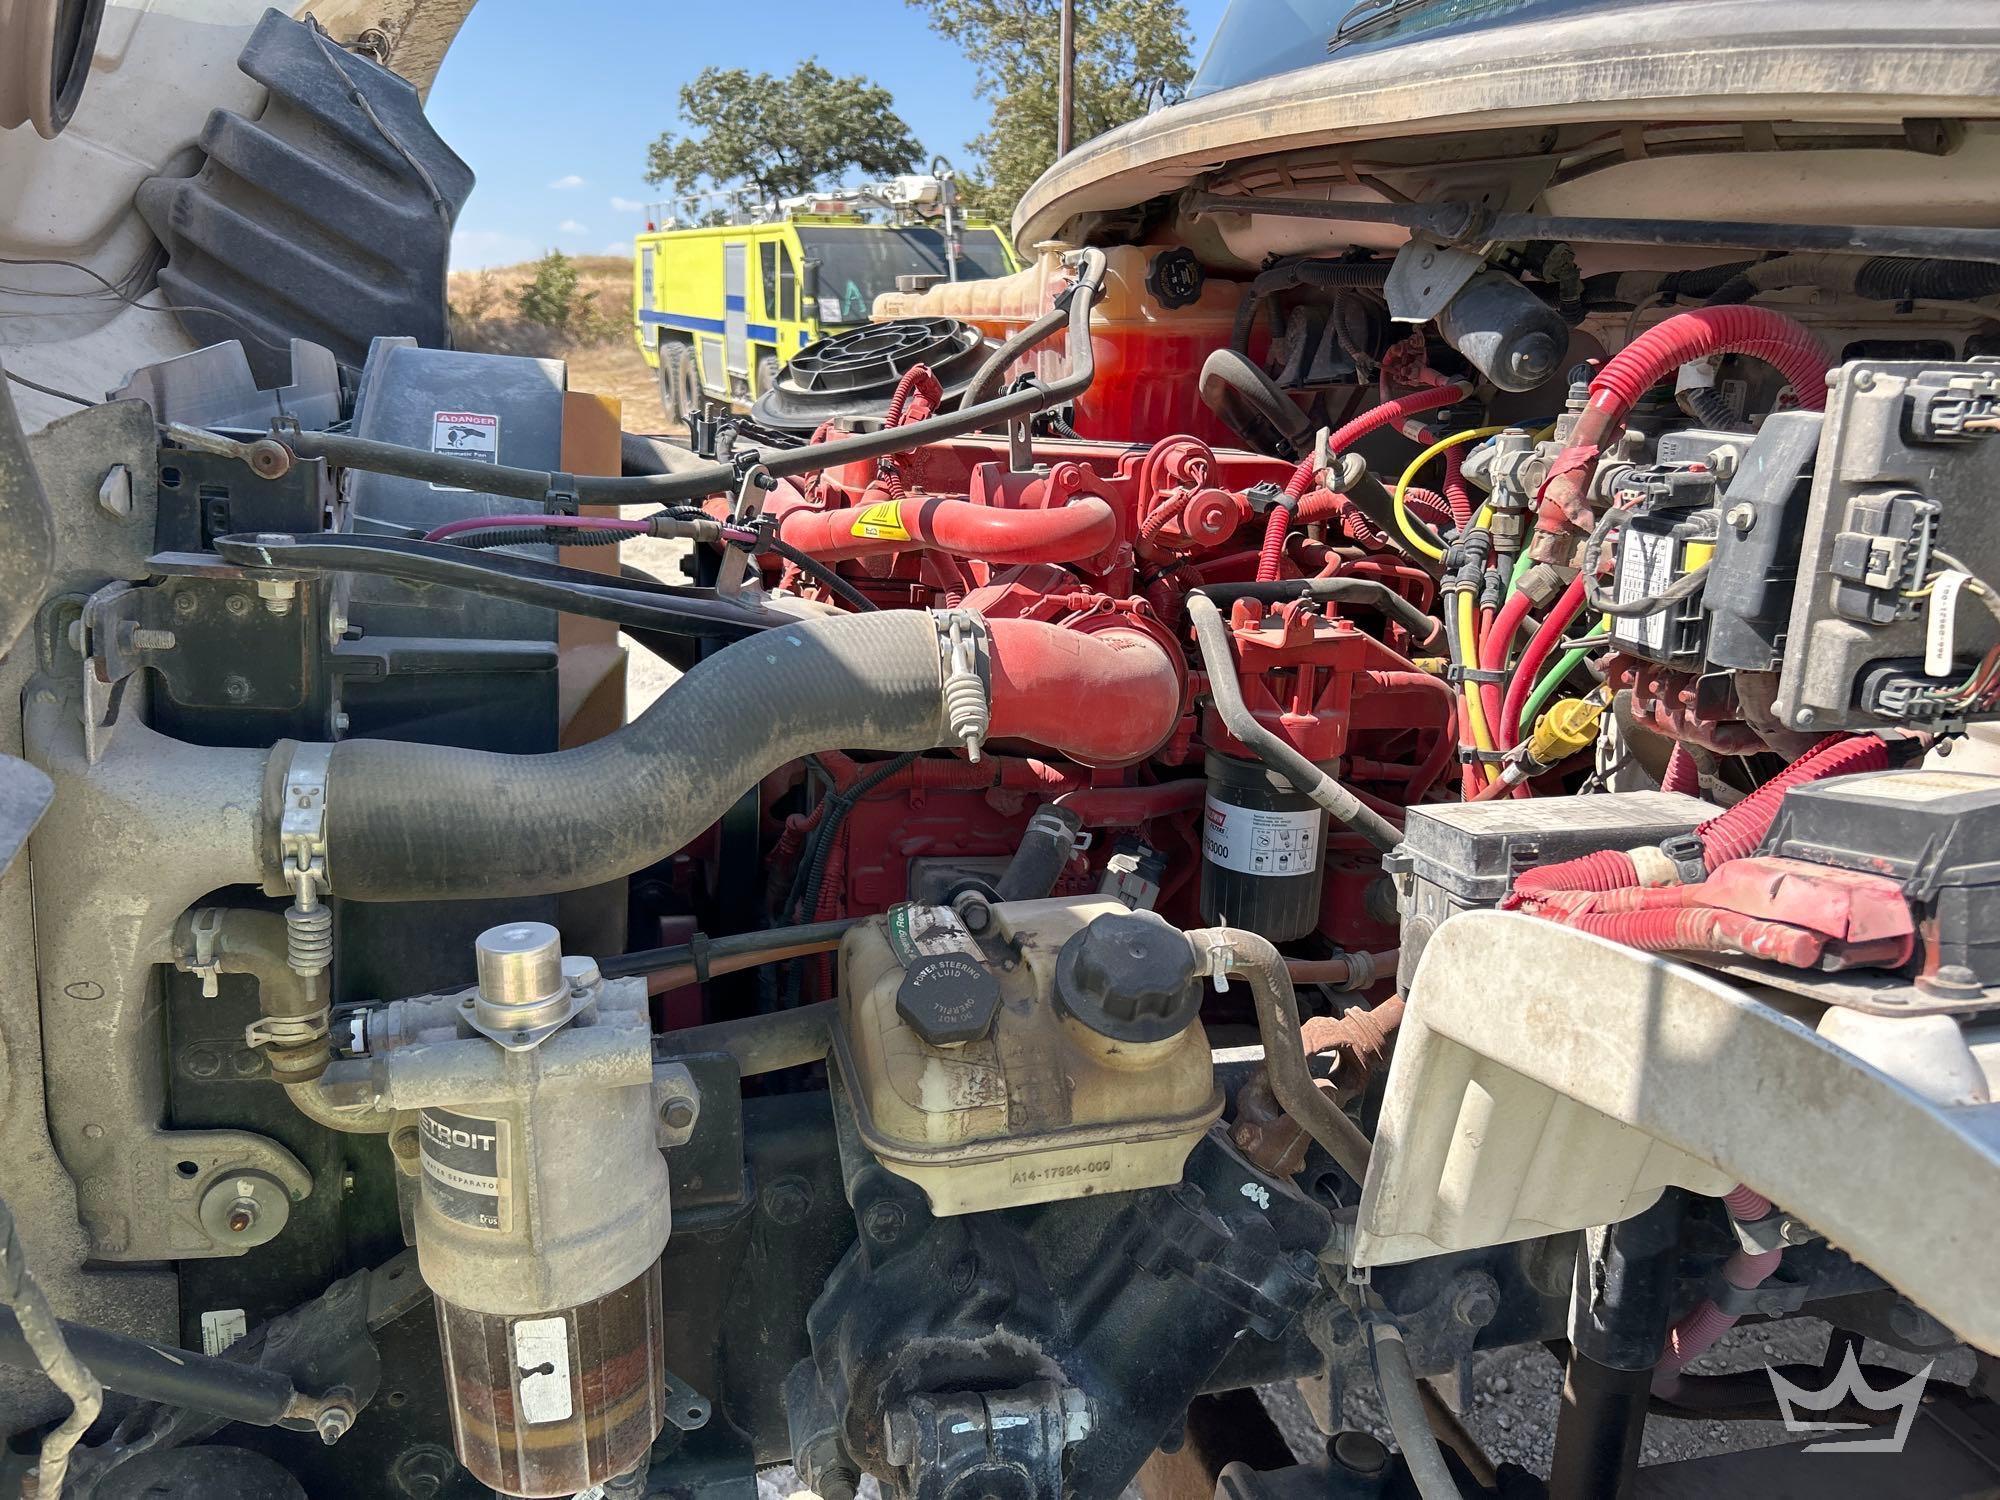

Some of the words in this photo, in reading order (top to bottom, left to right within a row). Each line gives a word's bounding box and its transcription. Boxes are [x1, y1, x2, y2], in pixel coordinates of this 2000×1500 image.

[843, 279, 866, 316] A
[451, 416, 495, 424] DANGER
[913, 963, 938, 987] POWER
[939, 961, 981, 980] STEERING
[931, 969, 961, 981] FLUID
[933, 998, 975, 1015] OVERFILL
[938, 1015, 957, 1023] NOT
[960, 1011, 973, 1021] DO
[421, 1111, 496, 1151] ETROIT
